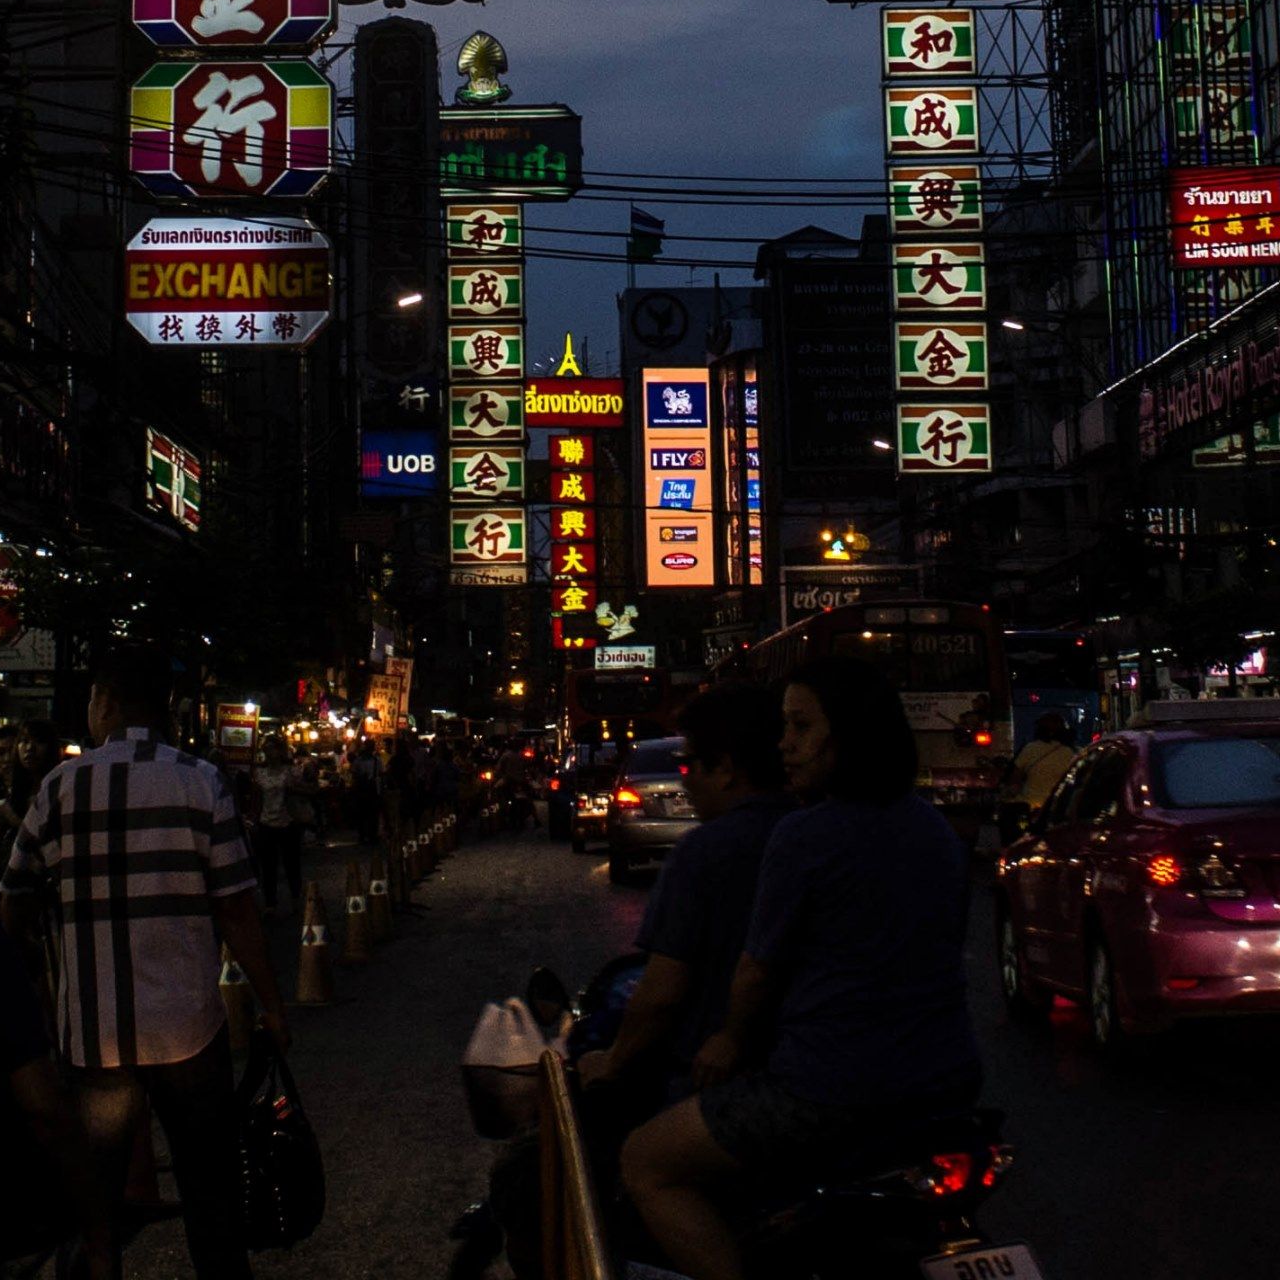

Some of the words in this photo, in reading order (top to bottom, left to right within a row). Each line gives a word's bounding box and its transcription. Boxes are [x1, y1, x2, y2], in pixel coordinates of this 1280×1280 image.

[1183, 187, 1272, 205] ร้านขายยา
[141, 227, 312, 245] รับแลกเงินตราต่างประเทศ
[908, 21, 968, 461] 和成興大金行
[1185, 243, 1209, 258] LIM
[1212, 242, 1249, 257] SOON
[128, 261, 330, 300] EXCHANGE
[1166, 368, 1203, 434] Hotel
[387, 452, 436, 475] UOB
[662, 450, 688, 467] FLY
